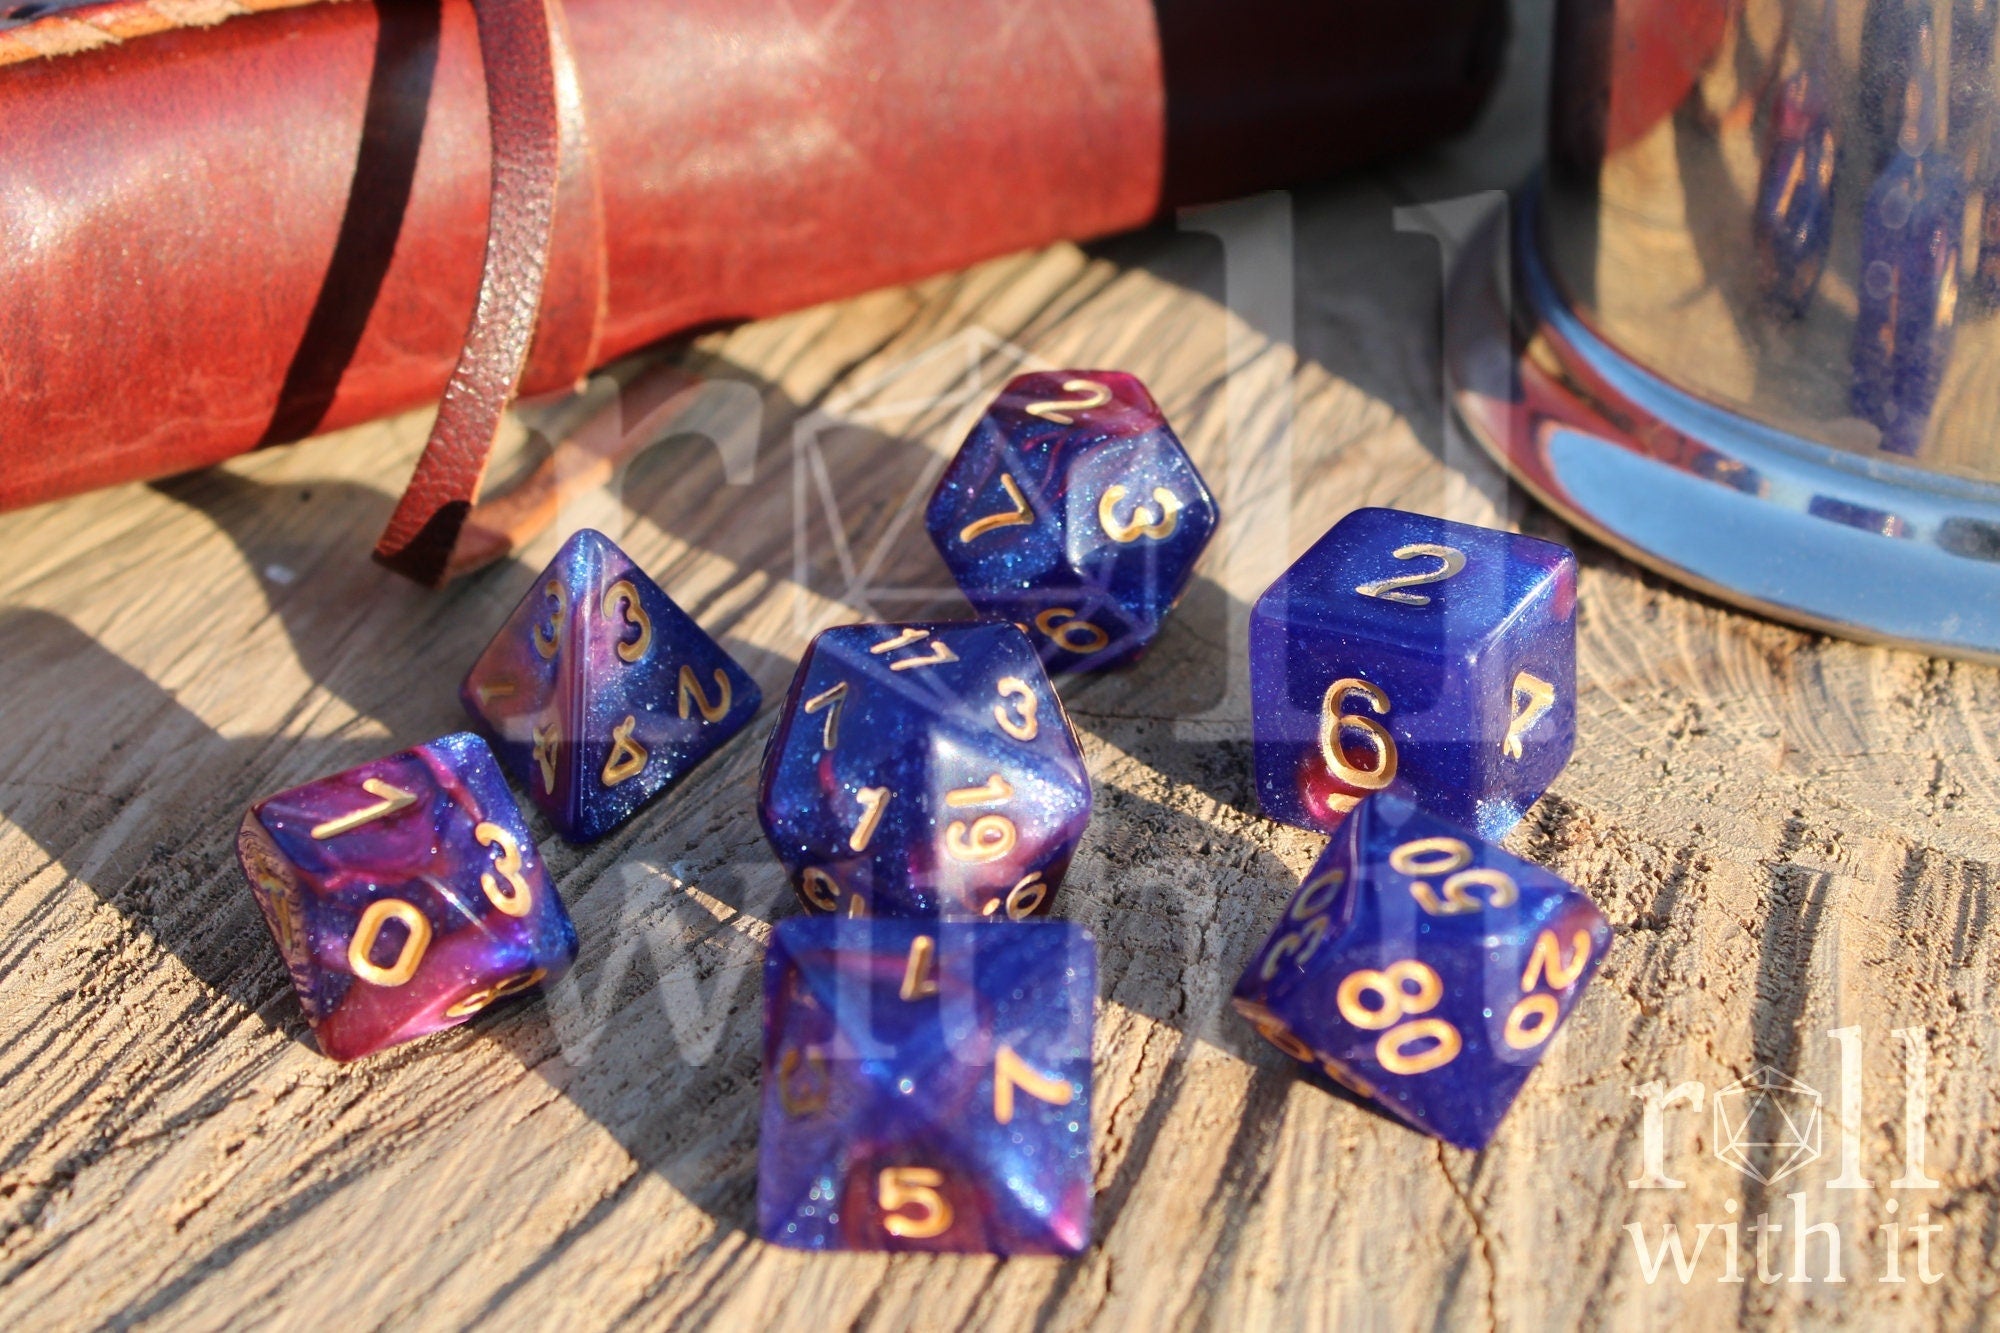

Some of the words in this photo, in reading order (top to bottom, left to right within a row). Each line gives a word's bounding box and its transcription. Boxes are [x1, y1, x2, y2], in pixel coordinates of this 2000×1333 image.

[1026, 380, 1112, 425] 2
[959, 472, 1036, 543] 7
[1099, 484, 1180, 543] 3
[1355, 542, 1467, 606] 2
[533, 579, 567, 661] 3
[602, 579, 653, 663] 3
[870, 627, 959, 672] 17
[678, 664, 732, 724] 2
[805, 681, 848, 751] 7
[994, 675, 1039, 742] 3
[1502, 671, 1556, 759] 4
[602, 714, 649, 787] 4
[1318, 677, 1398, 790] 6
[311, 777, 419, 840] 1
[849, 785, 892, 852] 1
[945, 773, 1017, 862] 19
[475, 821, 533, 918] 3
[1389, 836, 1519, 917] 50
[347, 897, 433, 989] 0
[1336, 959, 1463, 1076] 80
[1504, 928, 1592, 1051] 20
[993, 1044, 1074, 1125] 7
[878, 1166, 954, 1238] 5
